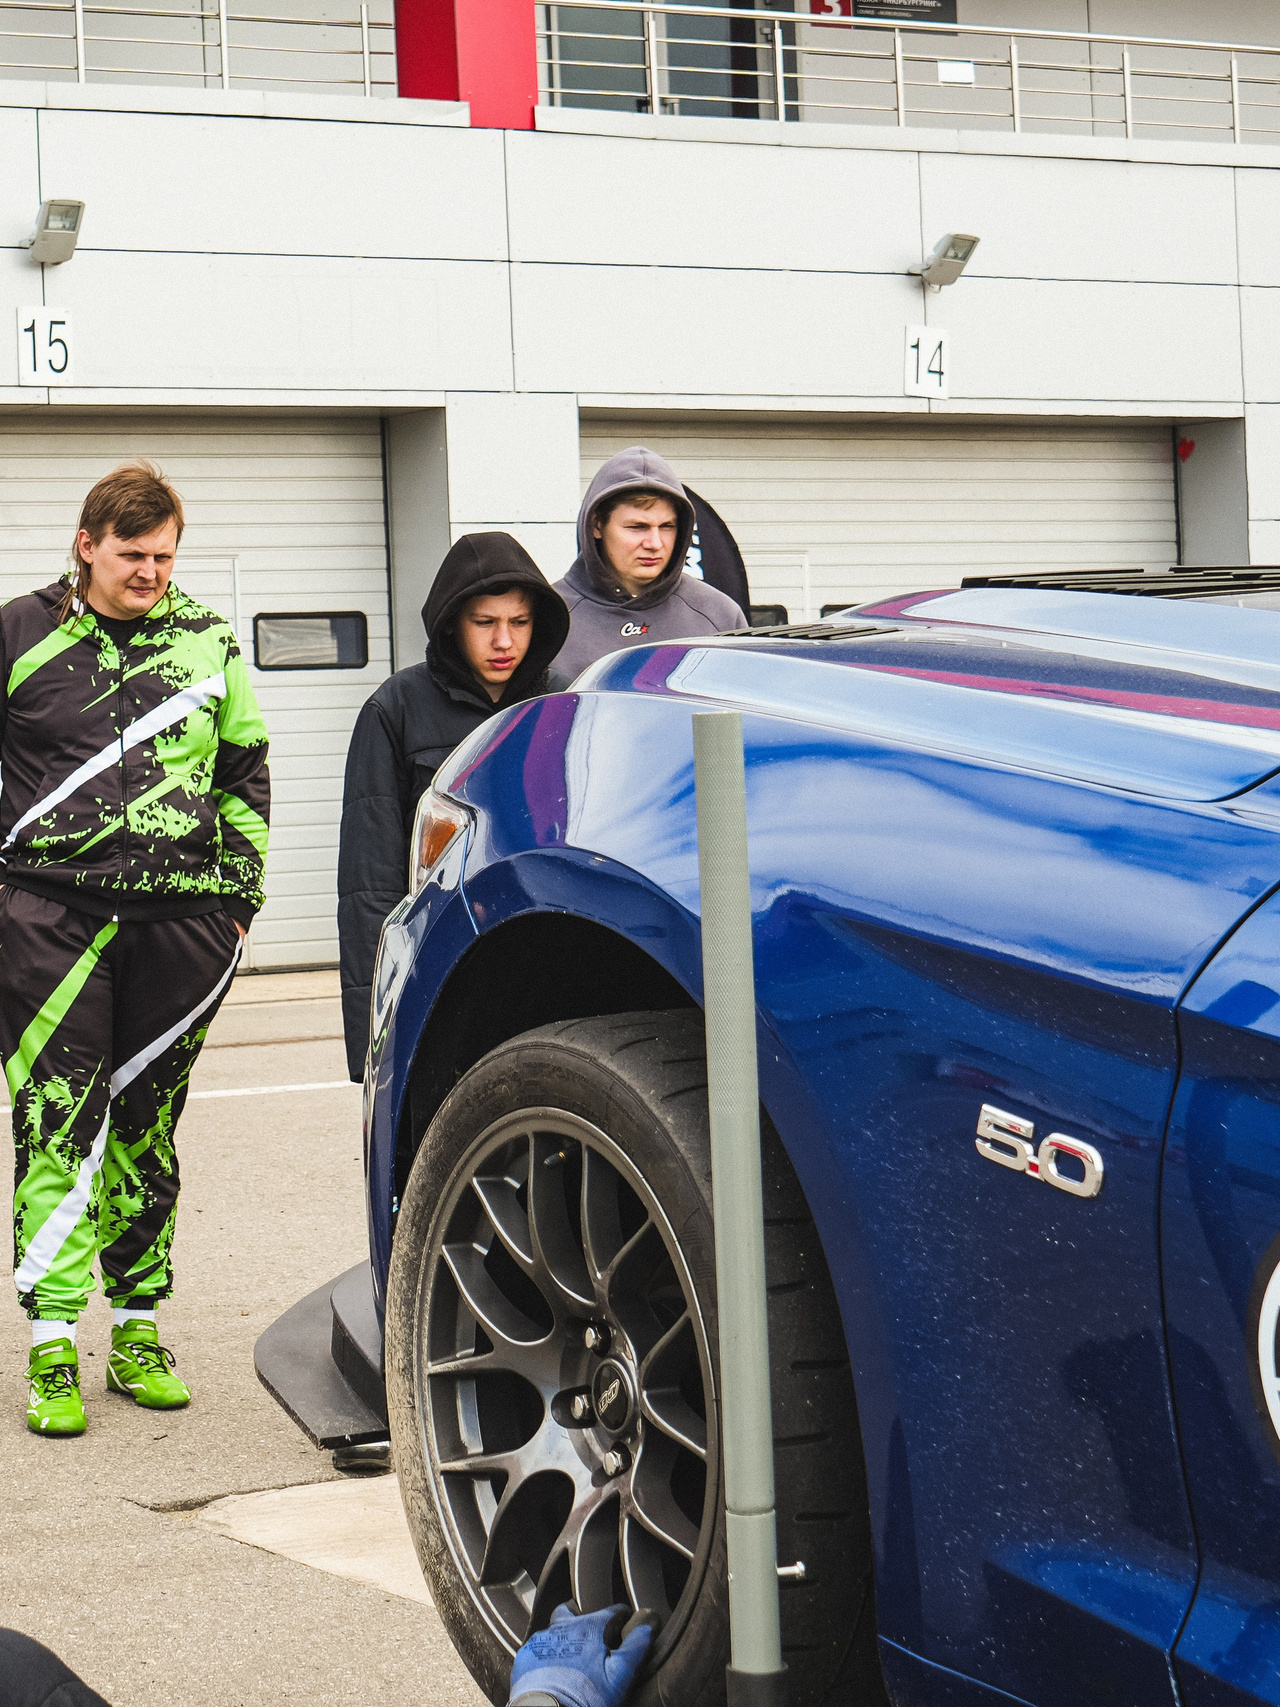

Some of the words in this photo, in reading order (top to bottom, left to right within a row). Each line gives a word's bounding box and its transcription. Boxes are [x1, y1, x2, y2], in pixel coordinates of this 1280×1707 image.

[23, 318, 69, 374] 15
[910, 337, 945, 388] 14
[974, 1102, 1105, 1199] 5.0
